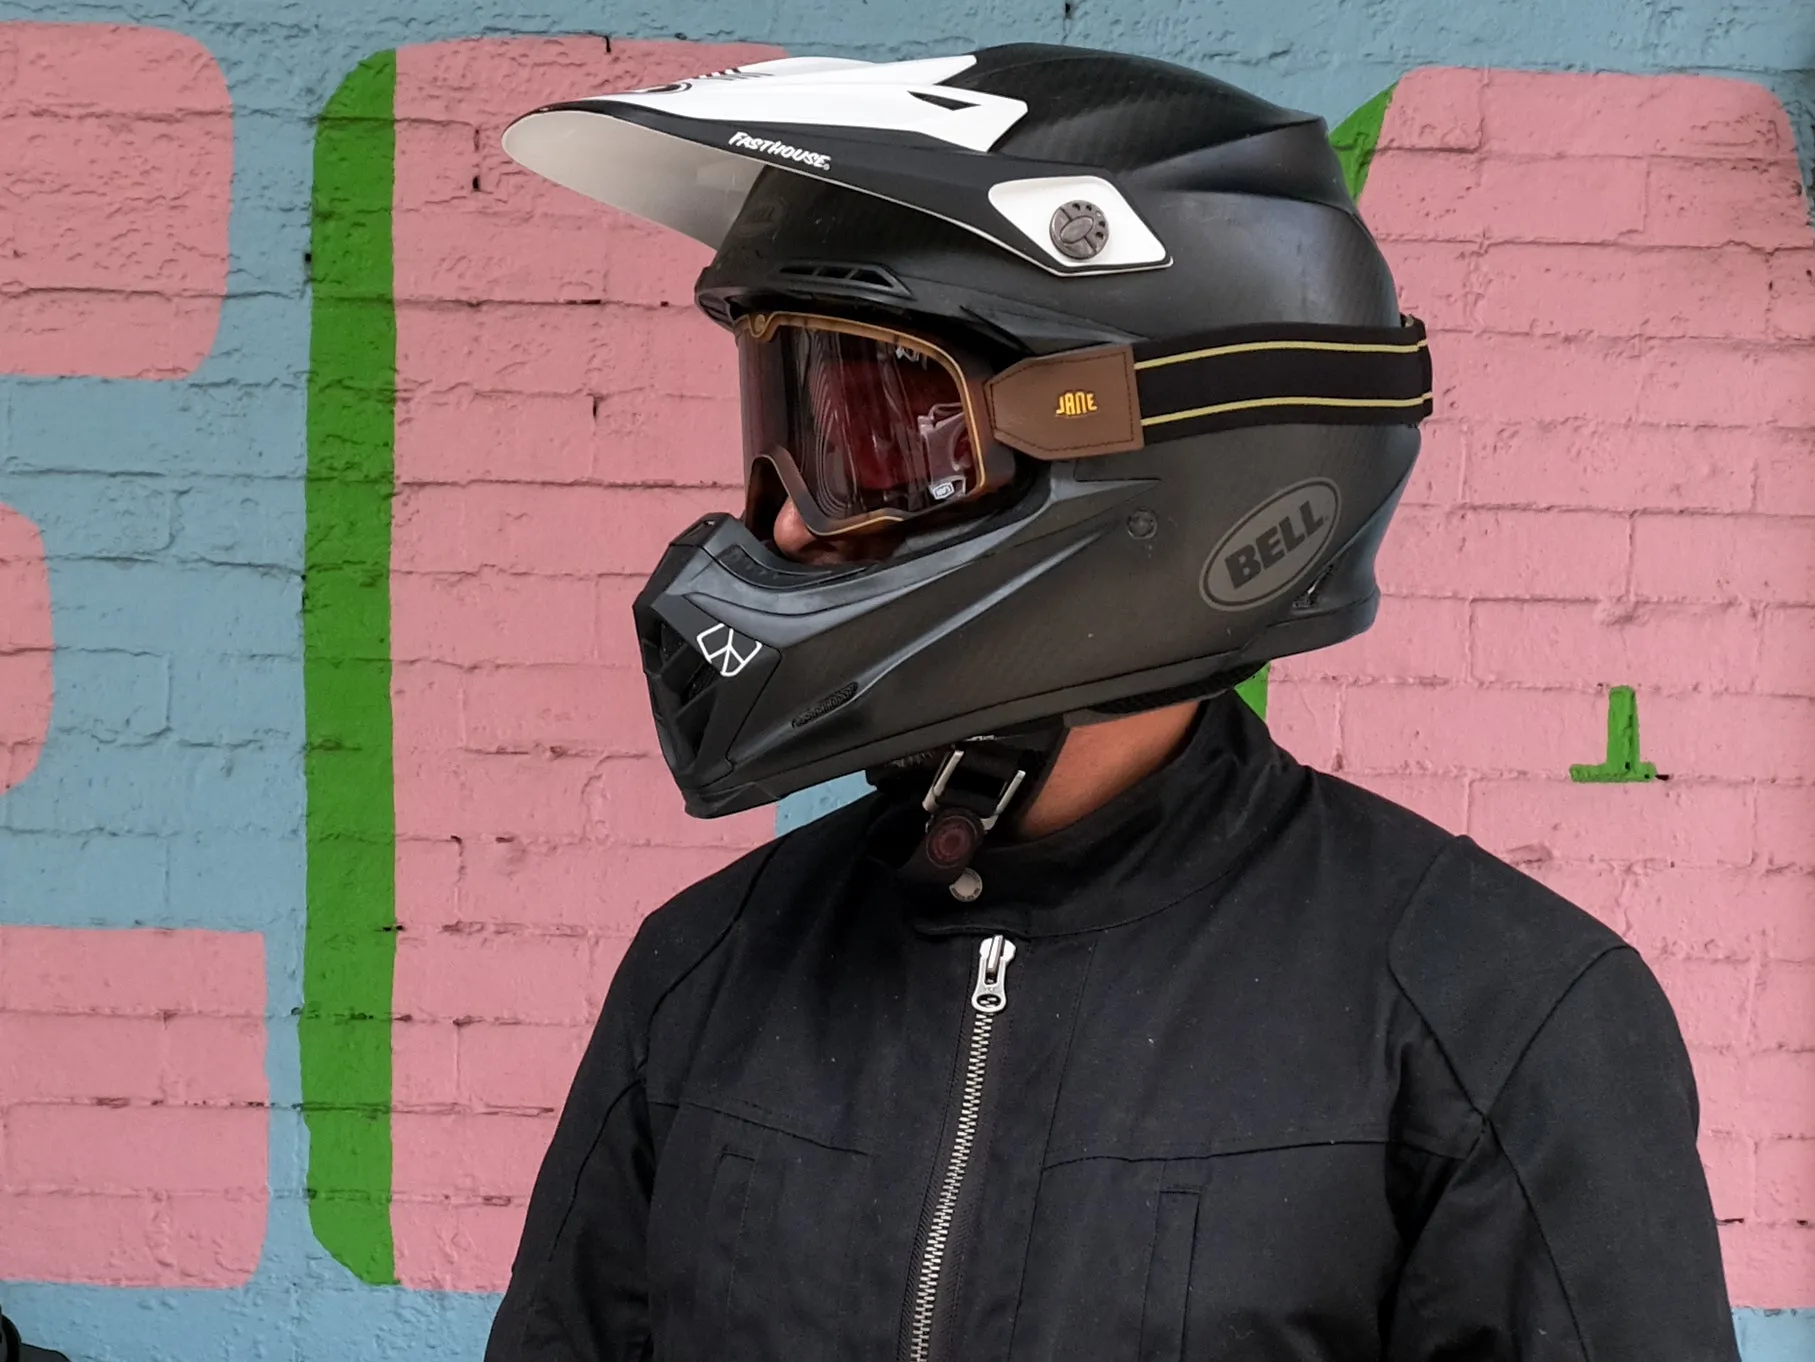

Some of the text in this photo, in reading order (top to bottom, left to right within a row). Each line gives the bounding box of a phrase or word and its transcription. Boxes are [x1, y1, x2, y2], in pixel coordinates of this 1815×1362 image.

[728, 131, 832, 169] FASTHOUSE
[1056, 391, 1098, 415] JANE
[1224, 500, 1324, 590] BELL
